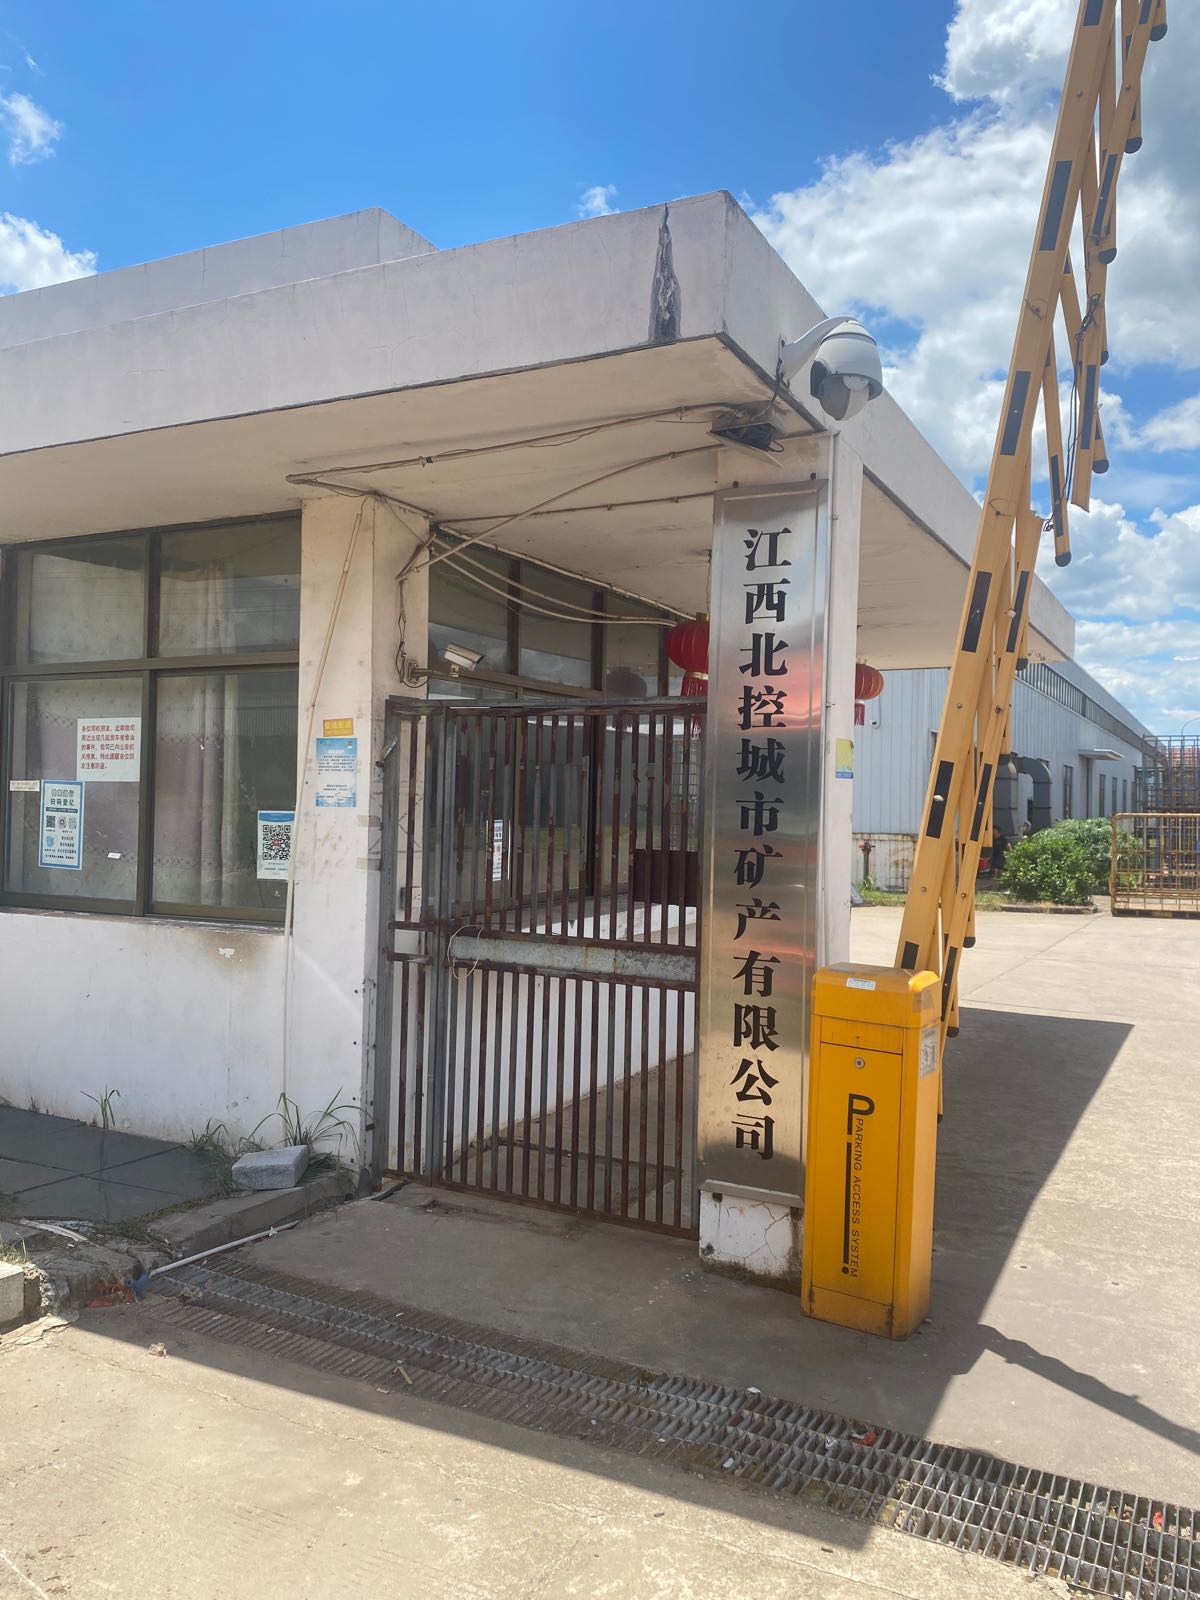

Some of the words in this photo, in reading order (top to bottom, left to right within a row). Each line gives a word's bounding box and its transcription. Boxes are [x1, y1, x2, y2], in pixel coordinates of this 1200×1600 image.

[730, 527, 792, 1160] 江西北控城市矿产有限公司
[847, 1093, 875, 1136] P
[853, 1117, 864, 1171] PARKING
[852, 1175, 862, 1225] ACCESS
[849, 1228, 860, 1279] SYSTEM
